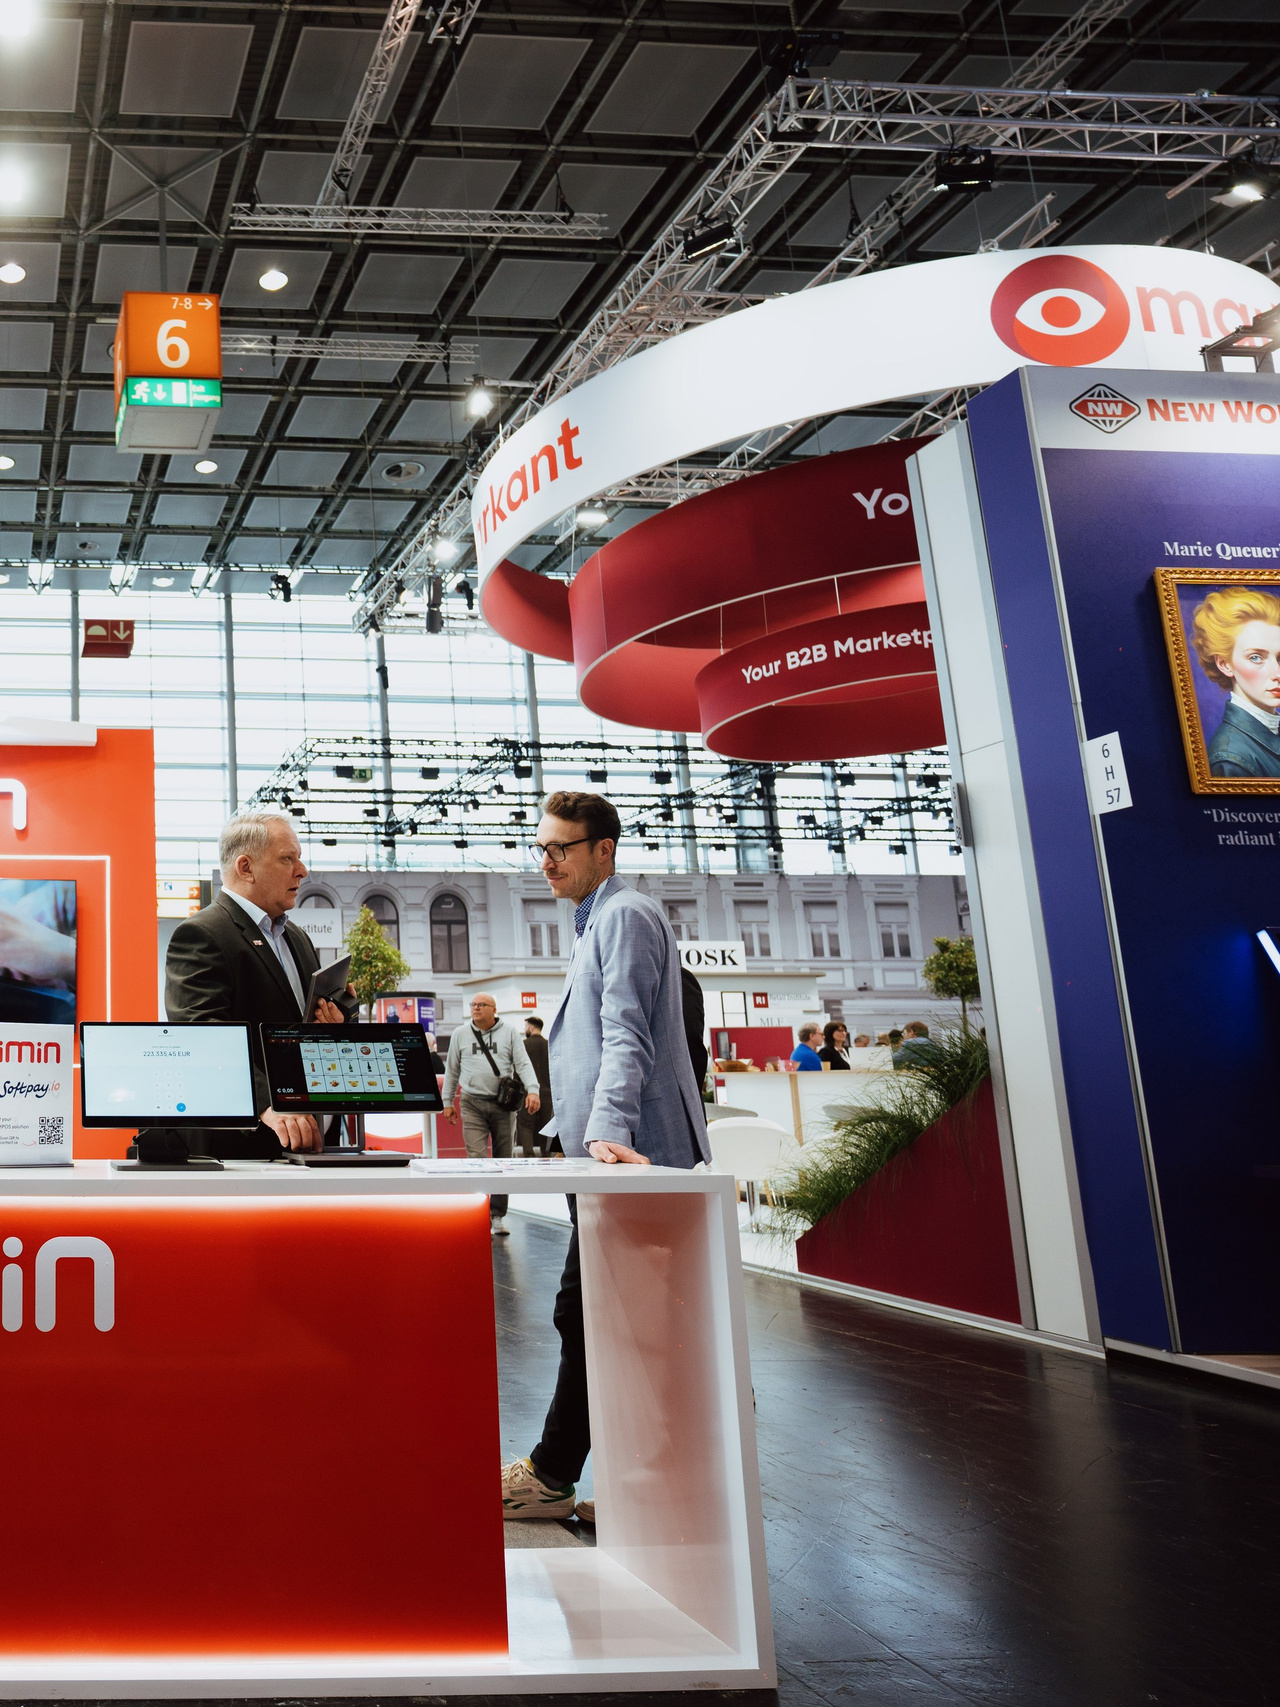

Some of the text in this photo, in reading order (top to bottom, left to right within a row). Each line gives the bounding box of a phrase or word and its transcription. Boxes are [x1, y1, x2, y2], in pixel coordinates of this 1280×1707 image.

[171, 297, 192, 310] 7-8
[156, 319, 190, 369] 6
[1087, 401, 1123, 416] NW
[1146, 398, 1280, 424] NEW WO
[477, 417, 583, 551] rkant
[1163, 541, 1280, 561] Marie Queuer
[741, 659, 782, 684] Your
[785, 644, 828, 670] B2B
[1101, 743, 1110, 759] 6
[1104, 765, 1115, 781] H
[1106, 787, 1121, 805] 57
[1217, 831, 1276, 846] radiant
